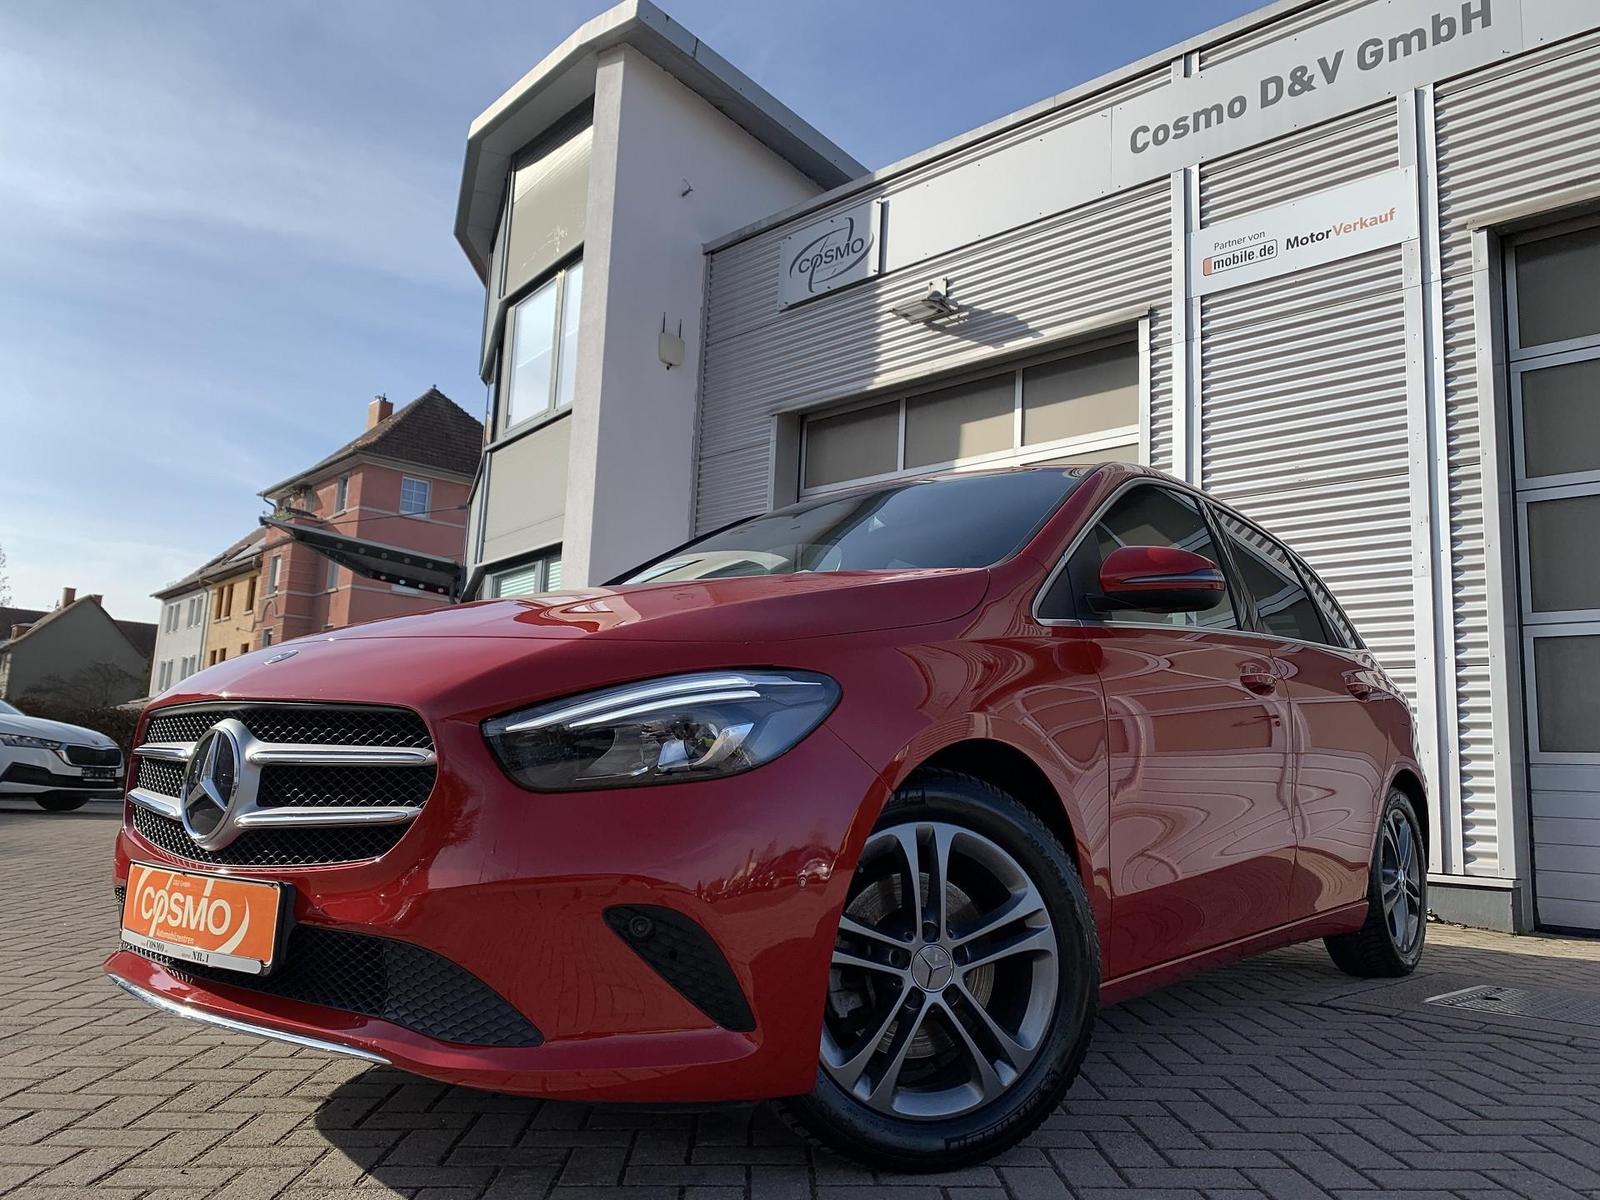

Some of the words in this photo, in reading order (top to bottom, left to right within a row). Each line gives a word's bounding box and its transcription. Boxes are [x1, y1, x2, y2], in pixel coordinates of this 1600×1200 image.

[1130, 94, 1247, 154] Cosmo
[1260, 49, 1344, 109] D&V
[1357, 0, 1492, 71] GmbH
[1214, 236, 1247, 251] Partner
[1248, 231, 1266, 242] von
[1285, 207, 1396, 250] MotorVerkauf
[798, 238, 864, 273] COSMO
[1213, 244, 1275, 270] mobile.de
[141, 886, 232, 935] COSMO
